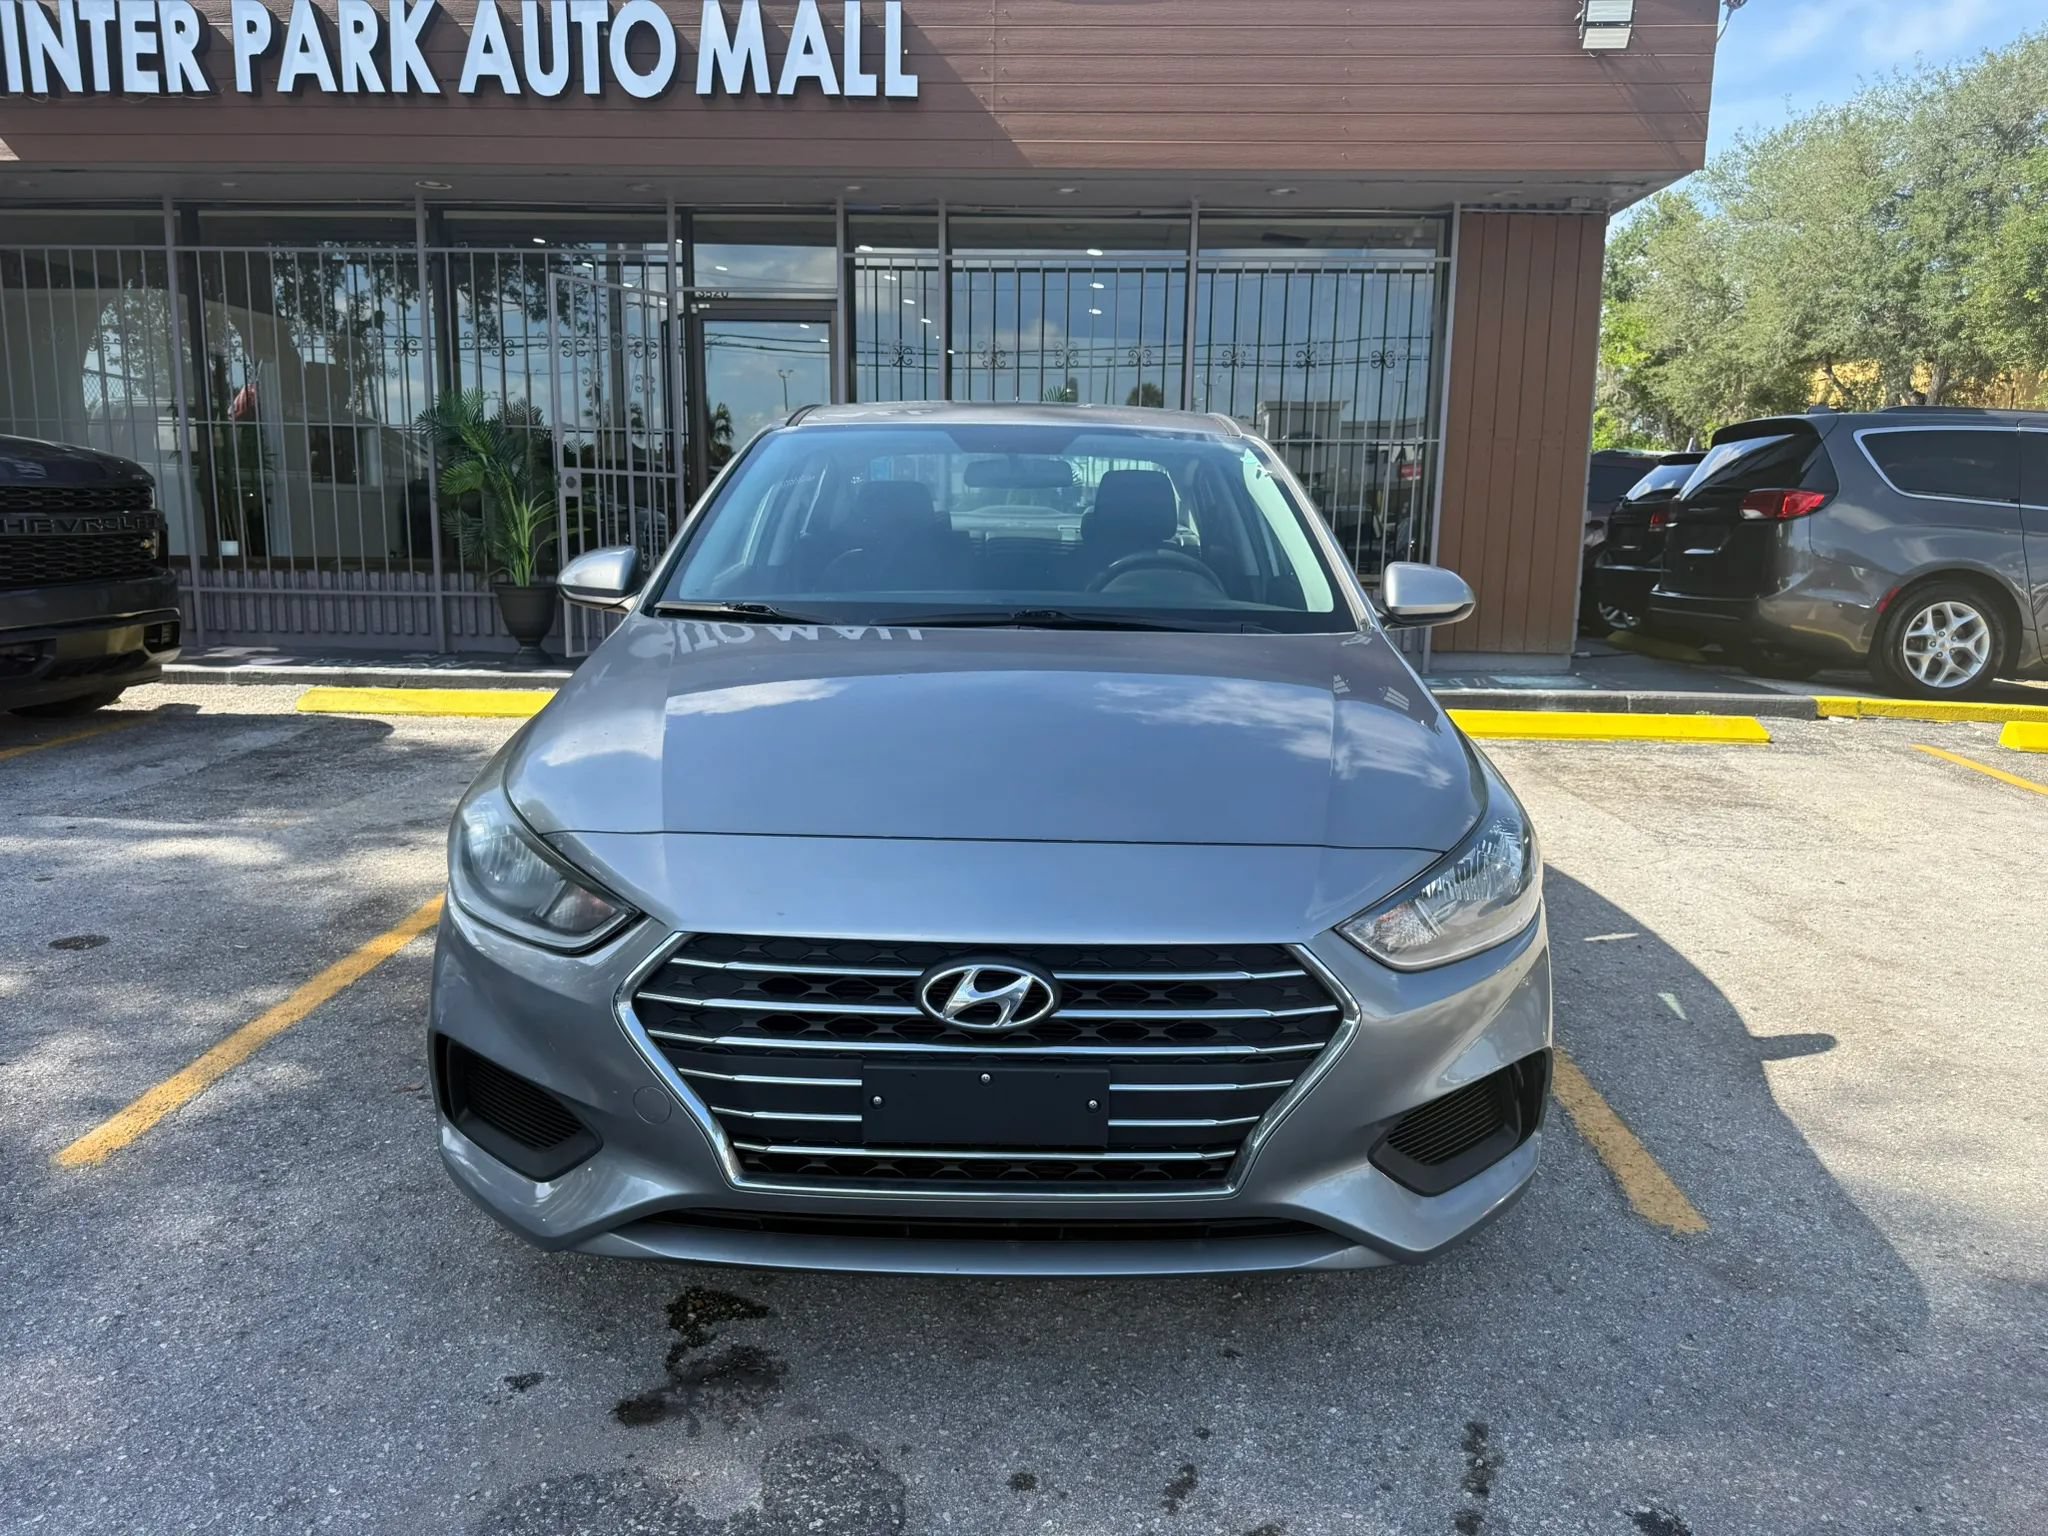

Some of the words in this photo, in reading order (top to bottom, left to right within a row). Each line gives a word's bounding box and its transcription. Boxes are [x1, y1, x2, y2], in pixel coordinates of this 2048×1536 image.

[231, 0, 441, 94] PARK
[458, 0, 677, 98] AUTO
[696, 0, 919, 97] MALL
